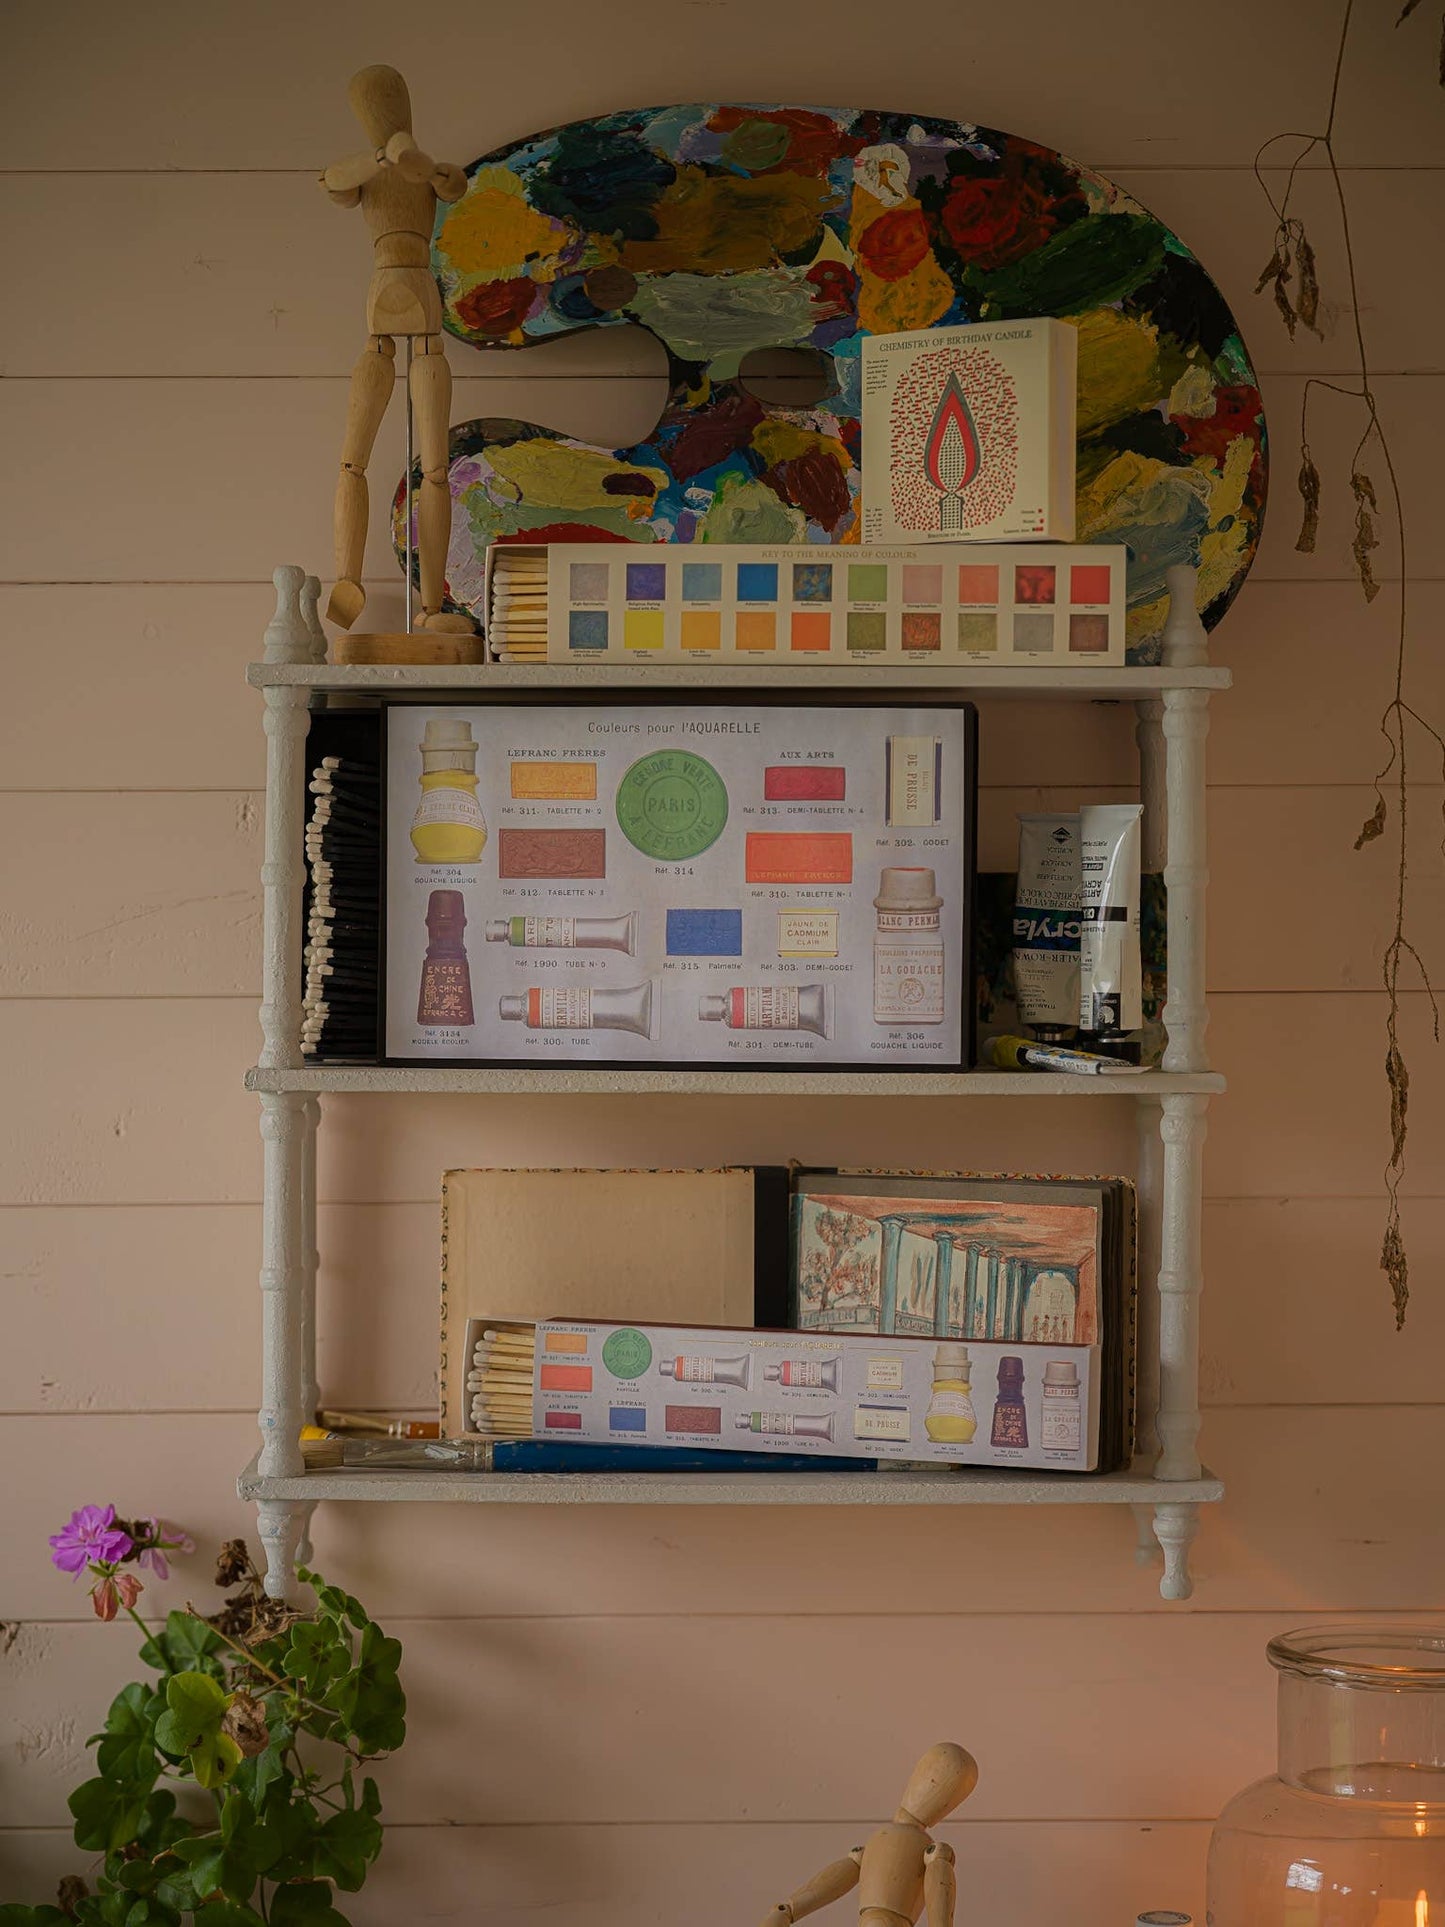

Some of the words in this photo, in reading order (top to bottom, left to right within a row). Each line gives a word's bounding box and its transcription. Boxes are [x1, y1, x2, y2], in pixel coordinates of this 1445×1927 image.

[879, 338, 930, 351] CHEMISTRY
[932, 338, 945, 347] OF
[946, 333, 993, 345] BIRTHDAY
[994, 329, 1034, 341] CANDLE
[761, 551, 778, 559] KEY
[780, 551, 795, 559] TO
[796, 551, 814, 559] THE
[816, 551, 858, 559] MEANING
[861, 551, 874, 559] OF
[876, 551, 917, 559] COLOURS
[588, 721, 641, 734] Couleurs
[647, 723, 675, 736] pour
[681, 721, 761, 734] l'AQUARELLE
[507, 749, 558, 758] LEFRANC
[779, 751, 801, 759] AUX
[806, 751, 835, 759] ARTS
[907, 753, 918, 767] DE
[682, 757, 716, 793] VERTE
[906, 773, 918, 811] PRUSSE
[647, 796, 696, 814] PARIS
[641, 815, 715, 850] LEFRANC
[566, 960, 586, 968] TUBE
[427, 966, 462, 975] ENCRE
[880, 964, 892, 975] LA
[896, 964, 943, 975] GOUACHE
[438, 986, 464, 994] CHINE
[906, 1032, 925, 1040] 306
[572, 1038, 590, 1046] TUBE
[870, 1042, 908, 1050] GOUACHE
[912, 1042, 944, 1050] LIQUIDE
